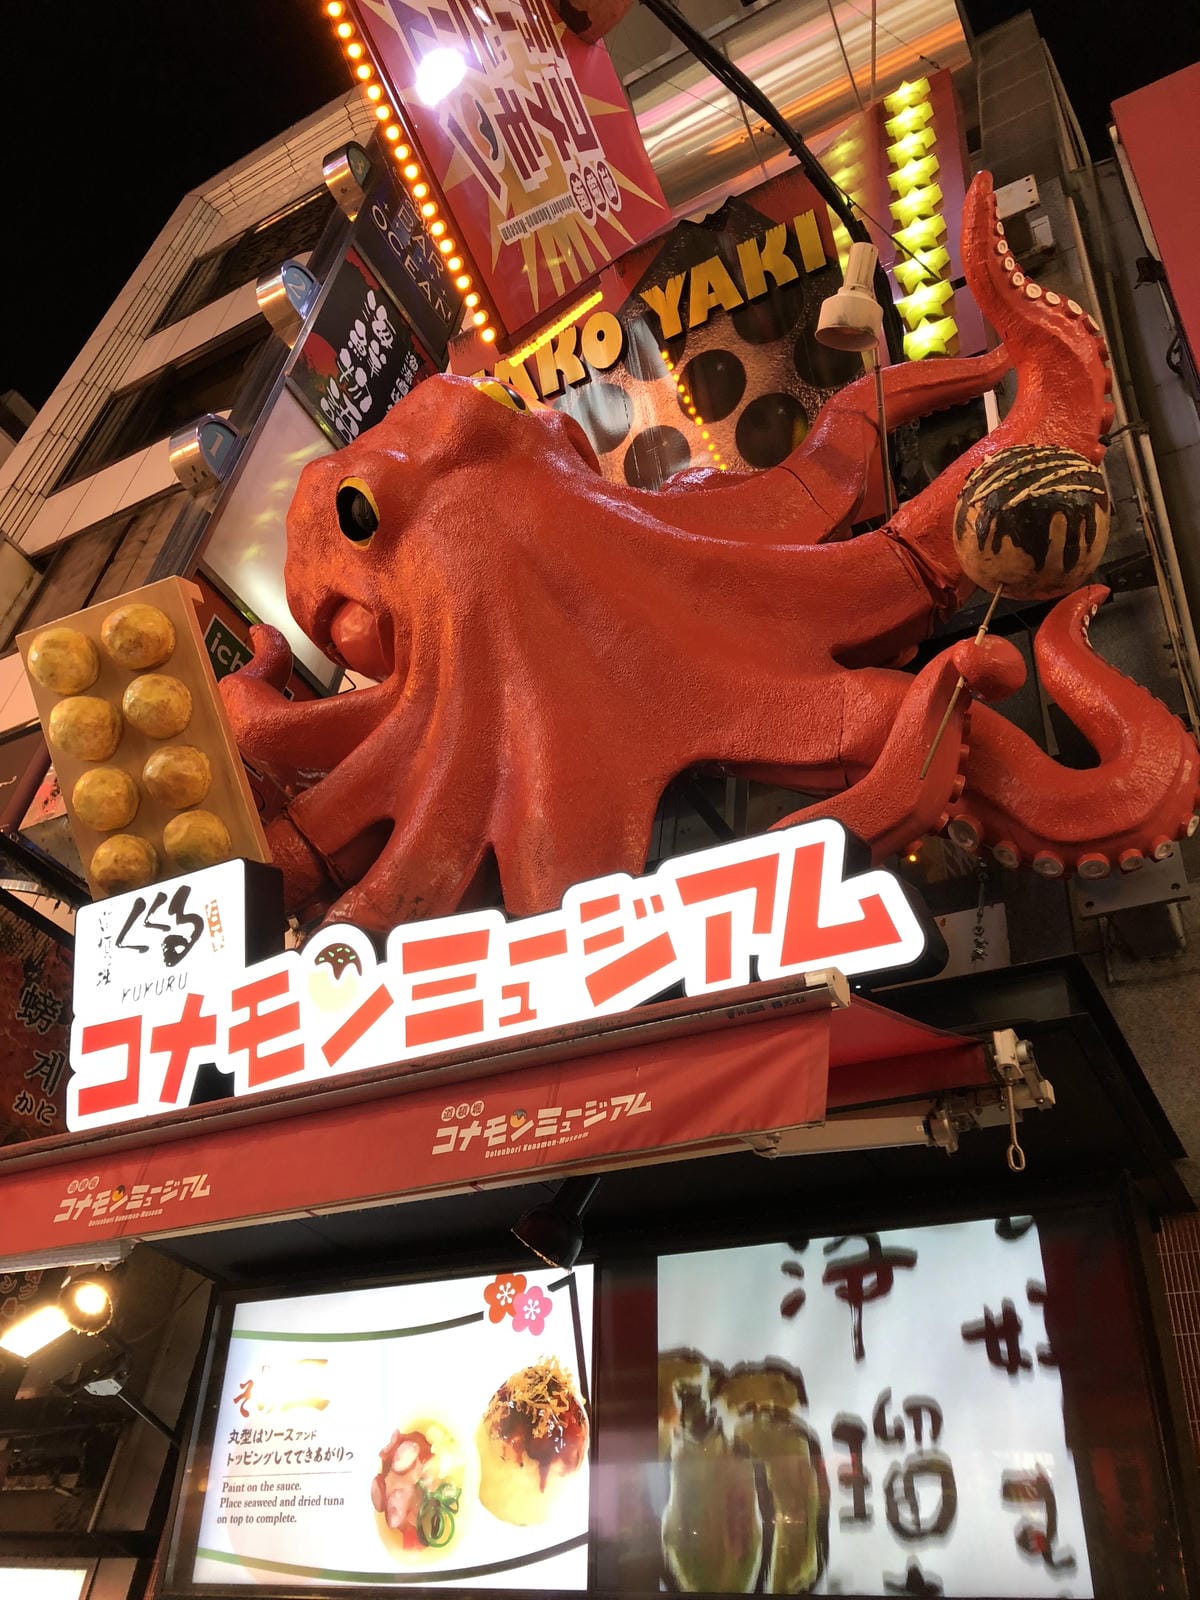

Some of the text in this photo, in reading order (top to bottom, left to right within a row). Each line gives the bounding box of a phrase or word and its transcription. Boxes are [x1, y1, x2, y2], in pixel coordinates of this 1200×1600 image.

[372, 204, 452, 321] OCEAN
[398, 205, 444, 278] BAR
[287, 273, 306, 300] 2
[470, 209, 828, 401] AKO YAKI
[320, 290, 397, 444] 海鮮物語
[209, 431, 225, 457] 1
[115, 884, 205, 968] くくる
[78, 841, 902, 1117] コナモンミュージアム
[13, 1090, 57, 1126] かに
[432, 1092, 652, 1155] コナモンミュージアム
[53, 1173, 210, 1223] コナモンミュージアム
[219, 1495, 345, 1508] Place seaweed and dried tuna
[222, 1480, 302, 1493] Paint on the sauce.
[217, 1511, 297, 1526] on top to complete.
